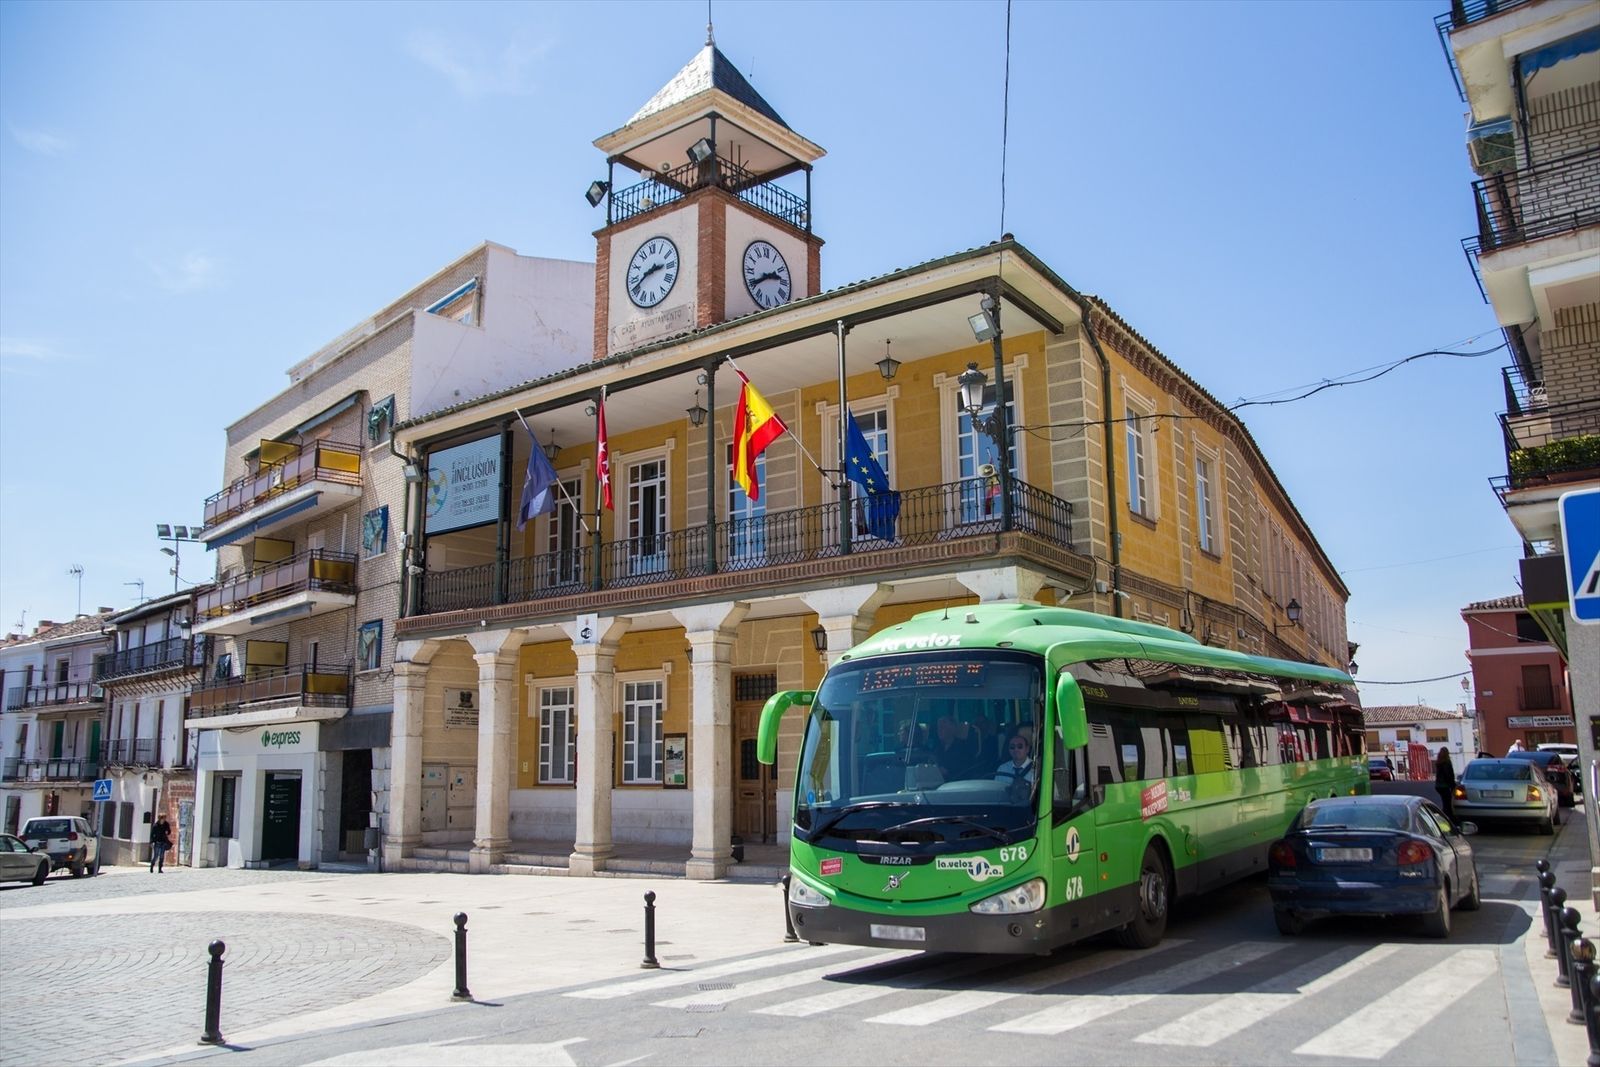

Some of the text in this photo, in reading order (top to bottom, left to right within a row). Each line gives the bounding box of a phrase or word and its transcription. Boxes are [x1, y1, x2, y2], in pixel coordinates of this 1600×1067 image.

[905, 633, 962, 649] veloz
[271, 730, 301, 750] express
[880, 855, 912, 865] IRIZAR
[1000, 846, 1028, 863] 678
[1065, 875, 1084, 901] 678
